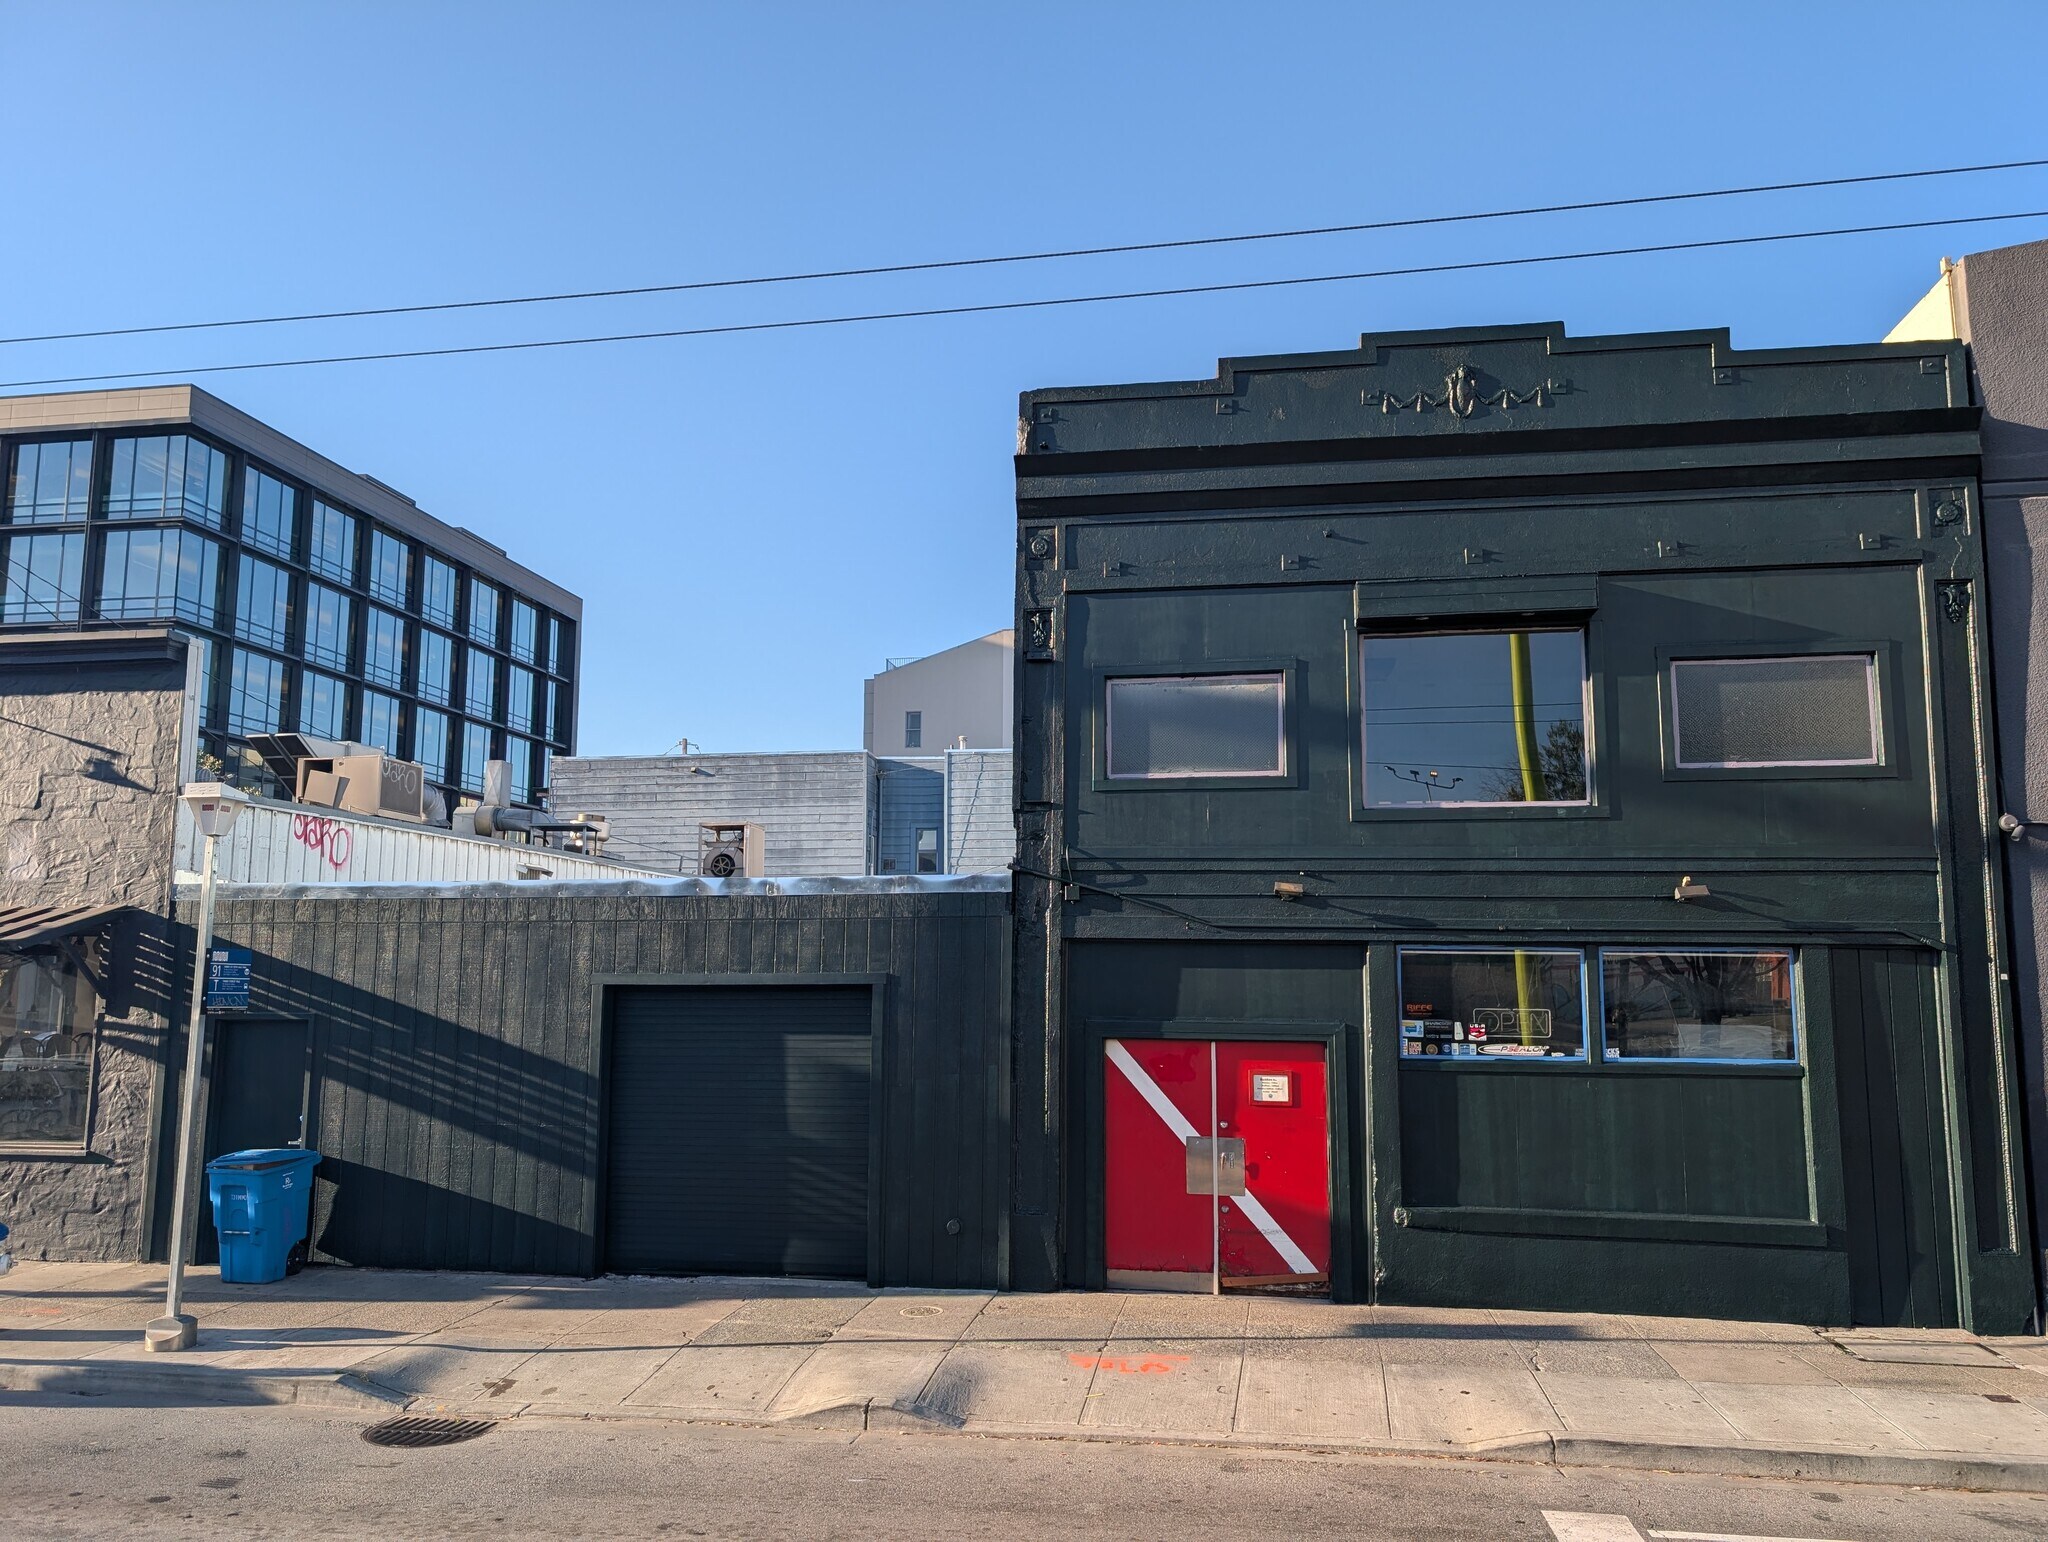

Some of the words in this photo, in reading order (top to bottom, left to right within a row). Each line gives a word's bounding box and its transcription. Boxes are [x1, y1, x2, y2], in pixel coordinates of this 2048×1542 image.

[212, 965, 221, 977] 91
[214, 980, 219, 991] T
[1478, 1011, 1548, 1034] OPEN
